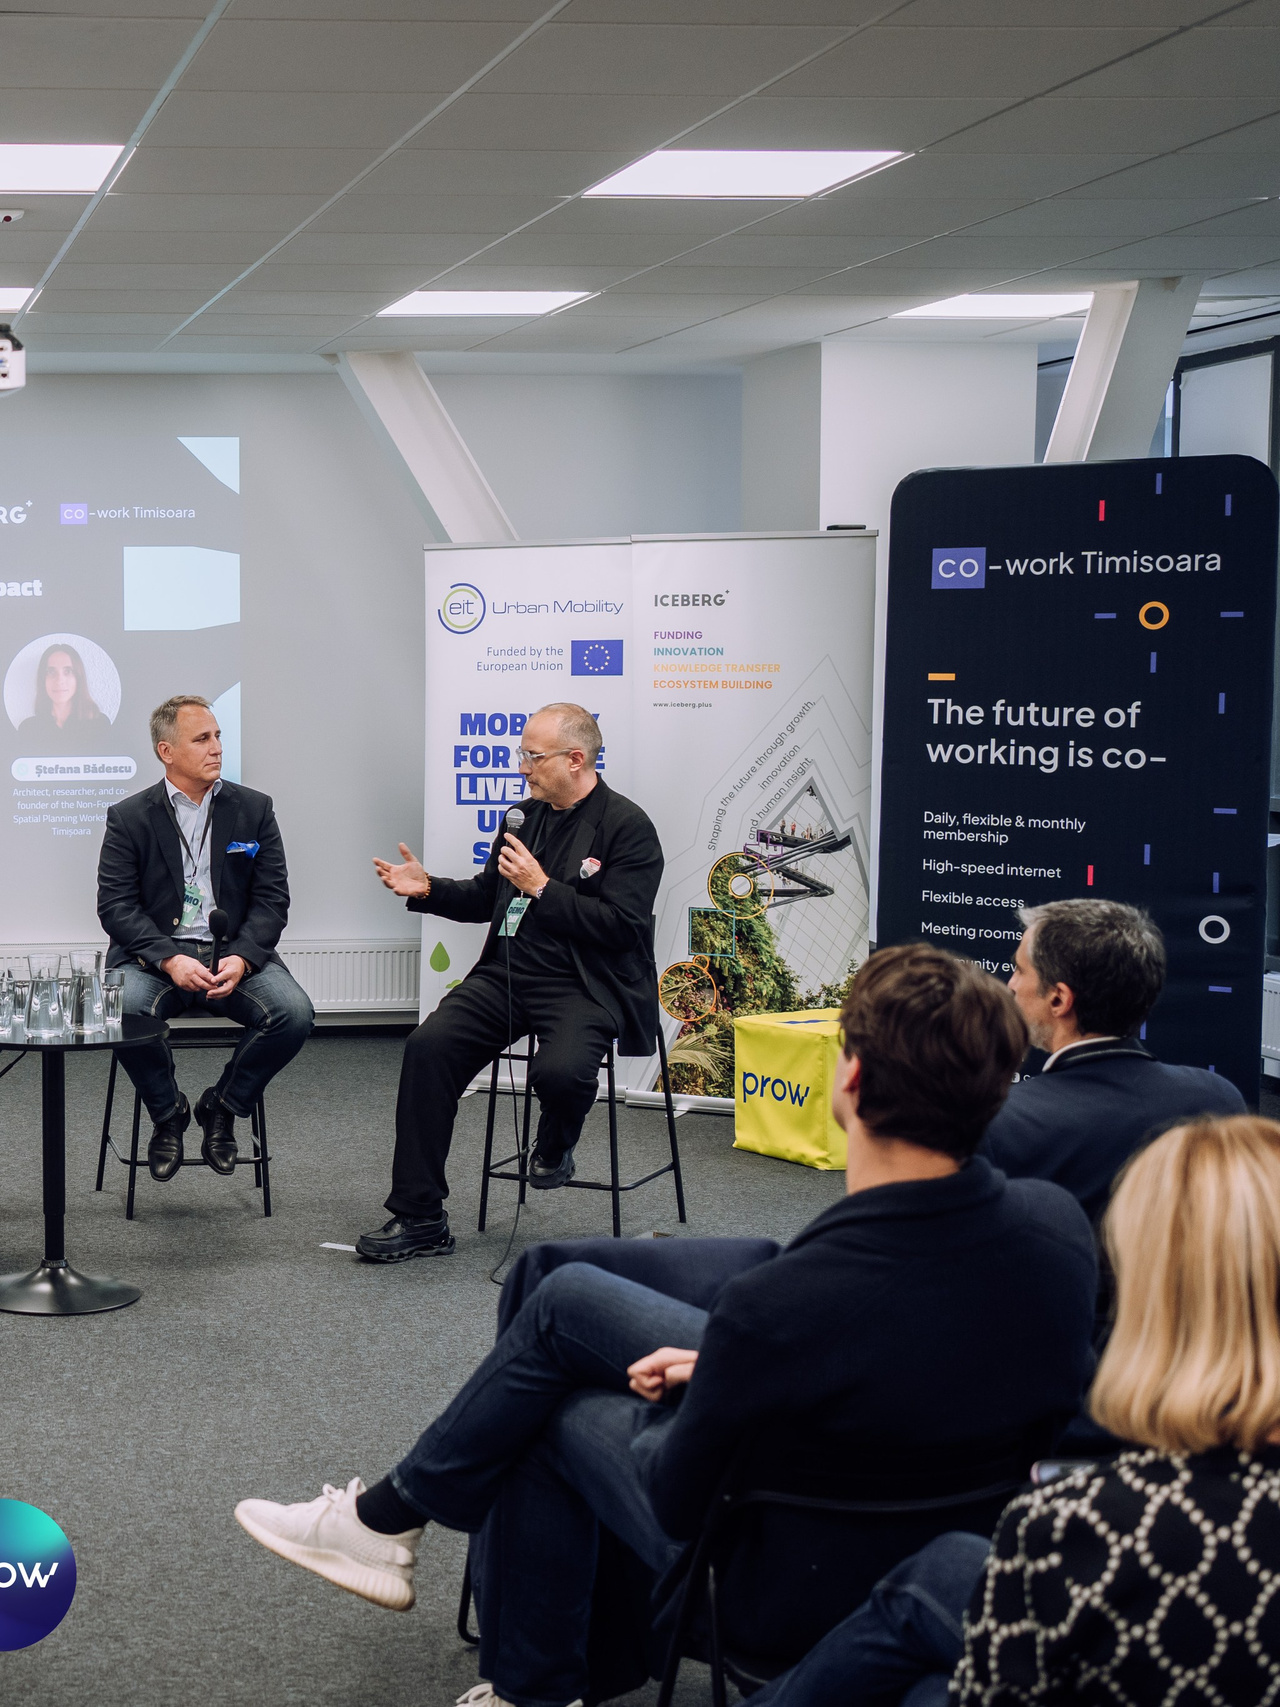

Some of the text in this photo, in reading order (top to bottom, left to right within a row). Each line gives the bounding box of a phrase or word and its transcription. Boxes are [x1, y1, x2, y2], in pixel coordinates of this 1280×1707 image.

[132, 506, 196, 519] Timisoara
[1081, 550, 1221, 575] Timisoara
[449, 599, 624, 616] eit Urban Mobility
[654, 630, 703, 640] FUNDING
[487, 646, 564, 659] Funded by the
[654, 647, 724, 656] INNOVATION
[476, 661, 564, 673] European Union
[654, 663, 780, 673] KNOWLEDGE TRANSFER
[653, 680, 773, 690] ECOSYSTEM BUILDING
[653, 701, 712, 709] www.iceberg.plus
[927, 698, 1141, 728] The future of
[454, 745, 511, 768] FOR
[926, 738, 1166, 773] working is co-
[83, 763, 132, 774] Bădescu
[758, 743, 801, 790] innovation
[708, 700, 816, 851] Shaping the future through growth,
[13, 788, 51, 797] Architect,
[53, 787, 97, 797] researcher,
[98, 787, 114, 795] and
[748, 756, 814, 840] and human insight.
[17, 801, 48, 810] founder
[50, 801, 59, 809] of
[61, 801, 75, 809] the
[13, 815, 40, 824] Spatial
[43, 814, 77, 825] Planning
[924, 810, 1086, 833] Daily, flexible & monthly
[923, 828, 1009, 845] membership
[922, 859, 1062, 879] High-speed internet
[921, 890, 1025, 909] Flexible access
[921, 921, 1023, 940] Meeting rooms
[743, 1071, 810, 1107] prow
